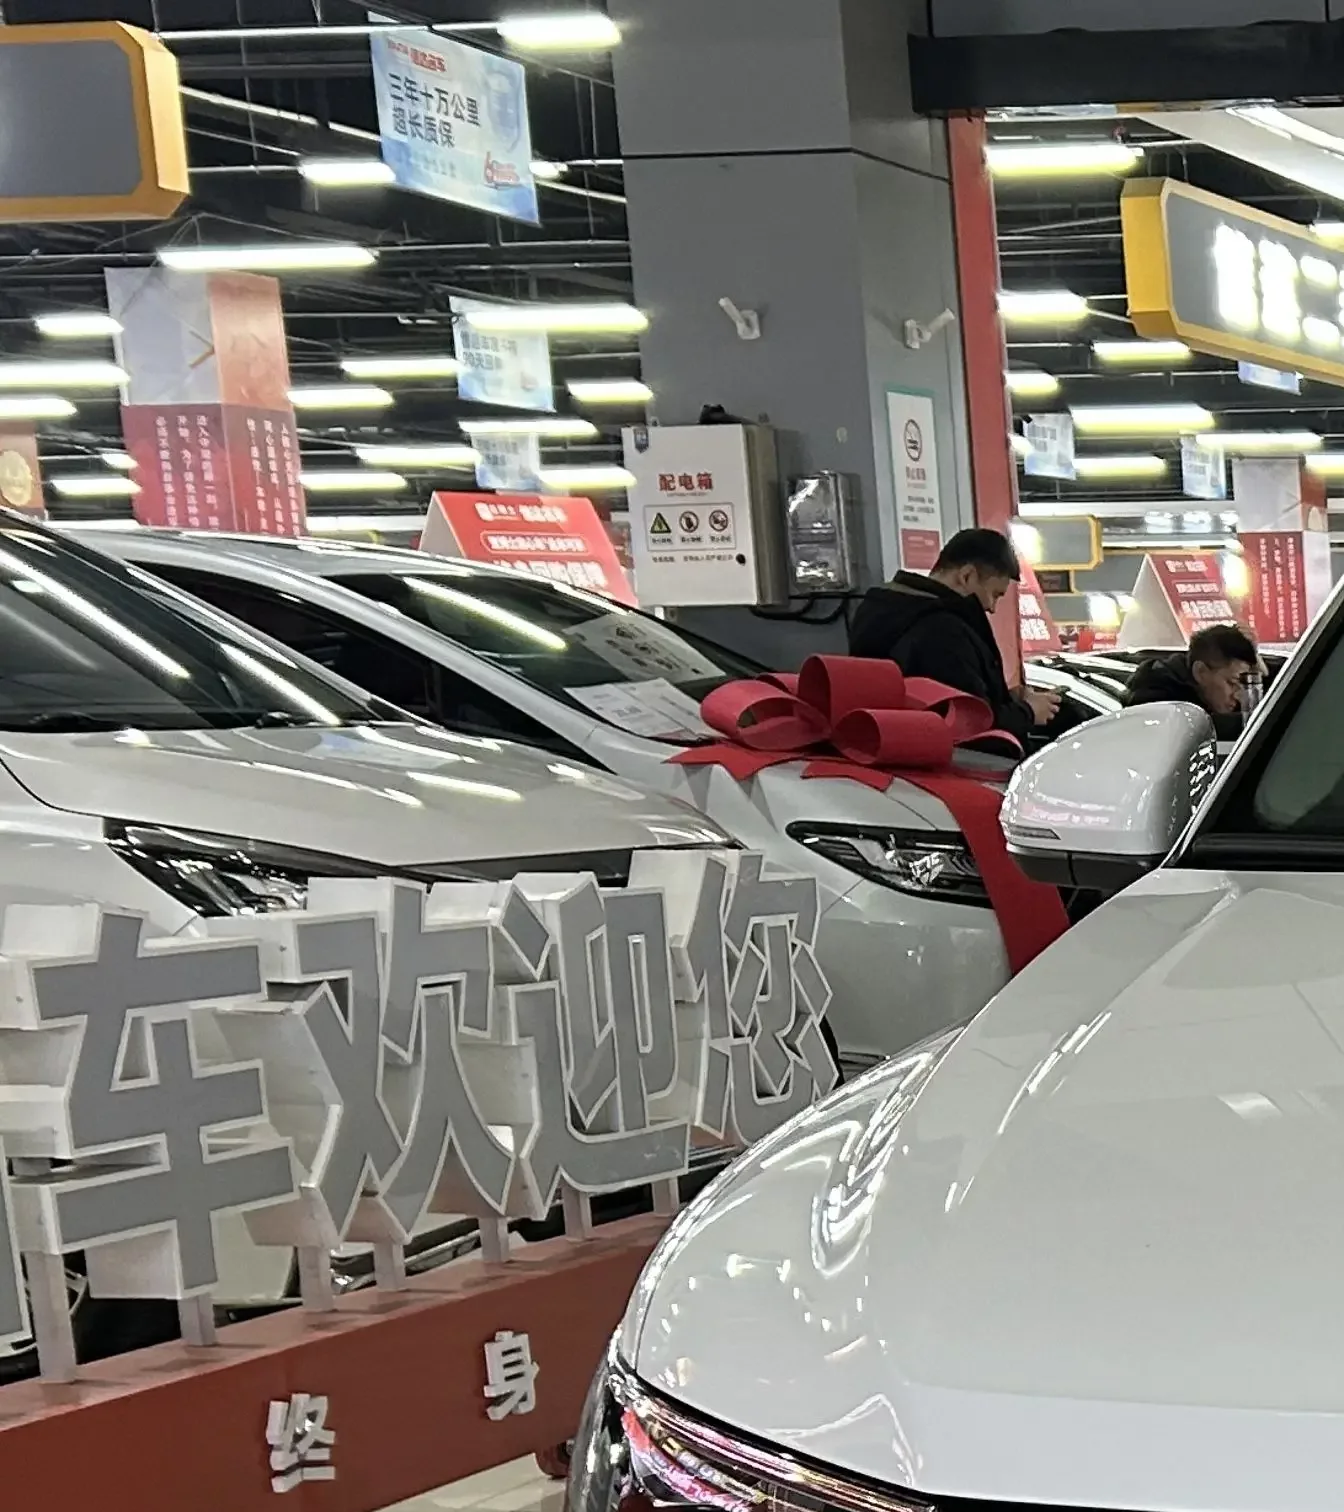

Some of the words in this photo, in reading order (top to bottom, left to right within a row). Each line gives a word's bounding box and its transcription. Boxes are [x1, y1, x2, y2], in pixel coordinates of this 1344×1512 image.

[388, 72, 481, 127] 三年十万公里
[392, 104, 455, 149] 超长质保
[658, 472, 714, 492] 配电箱
[0, 850, 840, 1340] 车欢迎您
